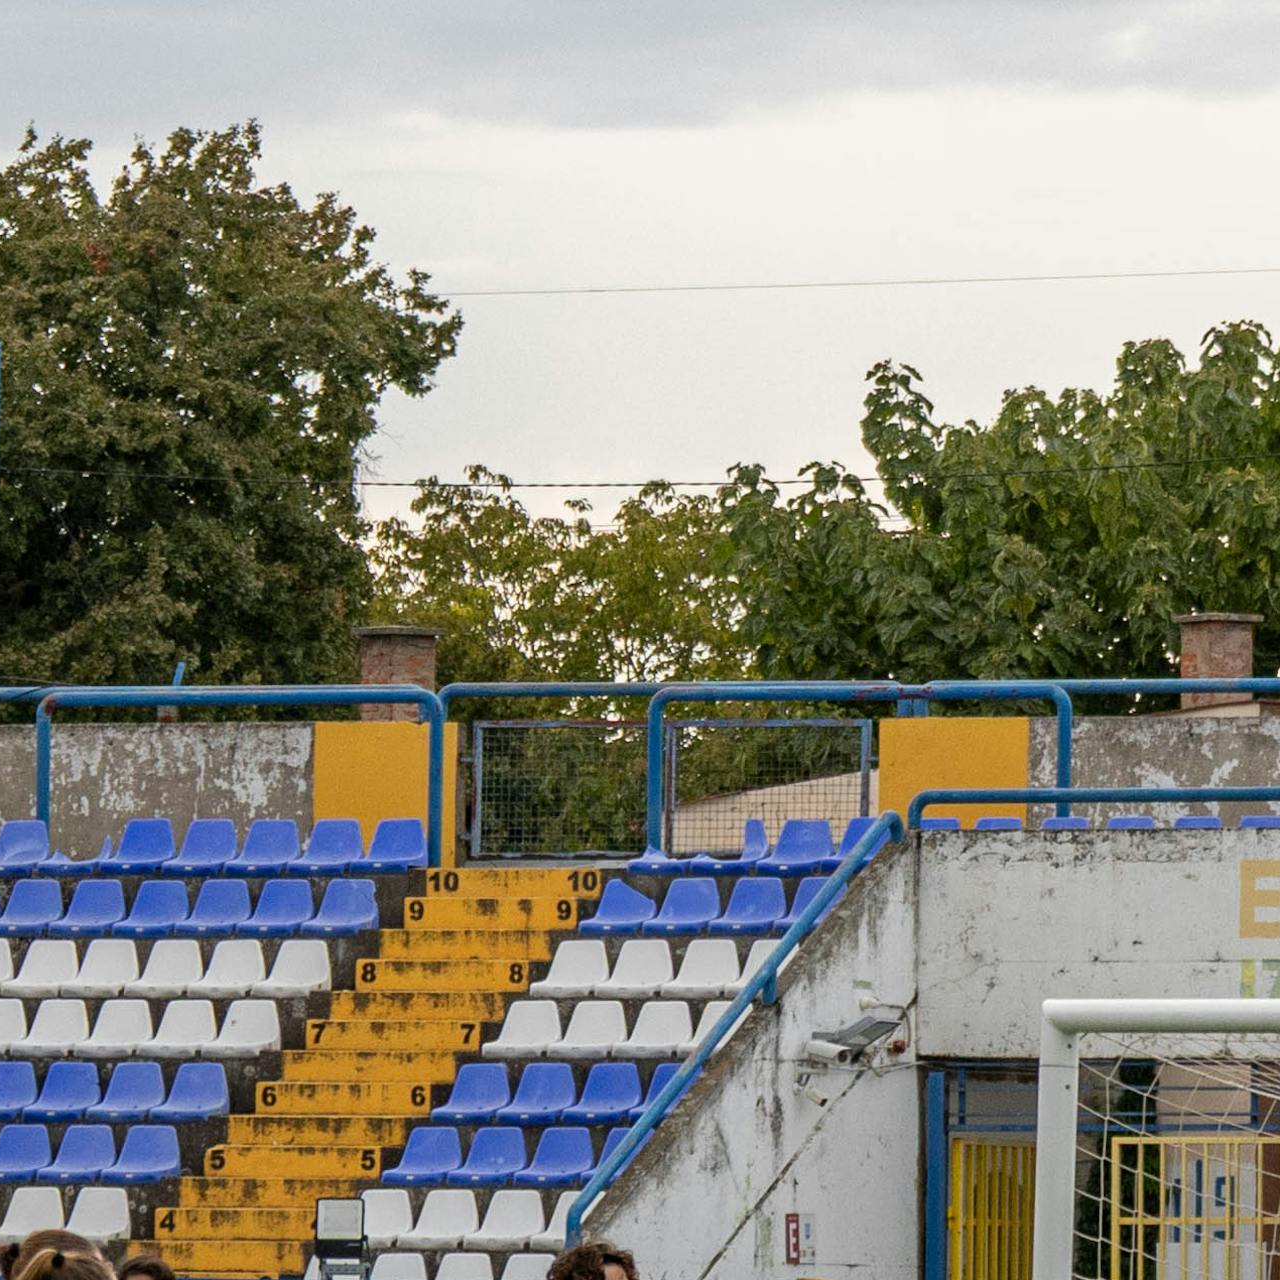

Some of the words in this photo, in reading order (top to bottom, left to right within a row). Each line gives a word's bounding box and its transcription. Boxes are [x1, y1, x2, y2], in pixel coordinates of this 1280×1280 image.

[428, 872, 459, 892] 10
[567, 872, 598, 892] 10
[409, 900, 424, 921] 9
[556, 900, 571, 920] 9
[361, 963, 376, 983] 8
[509, 963, 524, 983] 8
[311, 1024, 326, 1044] 7
[460, 1024, 476, 1044] 7
[261, 1086, 277, 1106] 6
[411, 1086, 426, 1106] 6
[209, 1150, 225, 1170] 5
[361, 1150, 376, 1171] 5
[159, 1212, 175, 1232] 4
